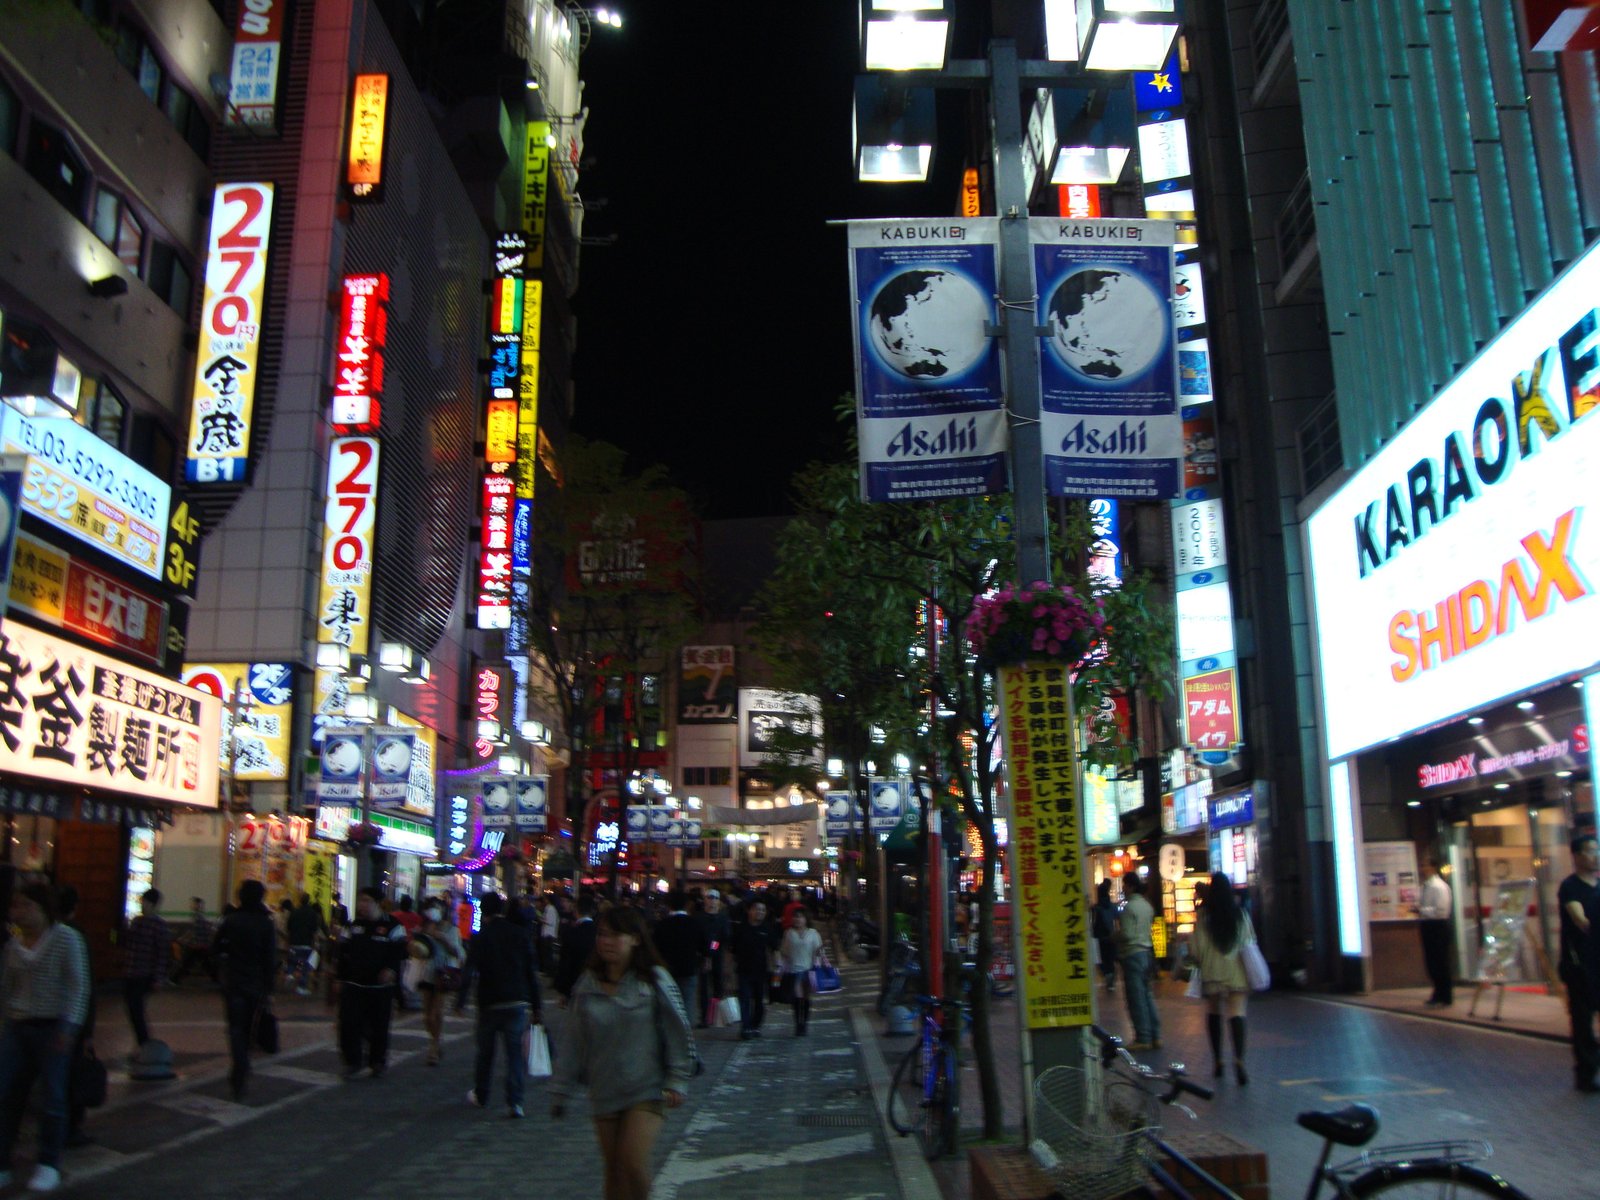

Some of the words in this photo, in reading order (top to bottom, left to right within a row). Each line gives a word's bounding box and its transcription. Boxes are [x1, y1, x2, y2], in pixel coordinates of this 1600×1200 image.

[887, 417, 977, 458] Asahi
[1061, 419, 1147, 455] Asahi
[1354, 308, 1600, 579] KARAOKE
[197, 458, 235, 482] B1
[171, 501, 200, 546] 4F
[166, 543, 197, 590] 3F
[1389, 507, 1586, 683] SHIDAX
[1189, 700, 1231, 716] アダム
[1417, 753, 1477, 788] SHIDAX
